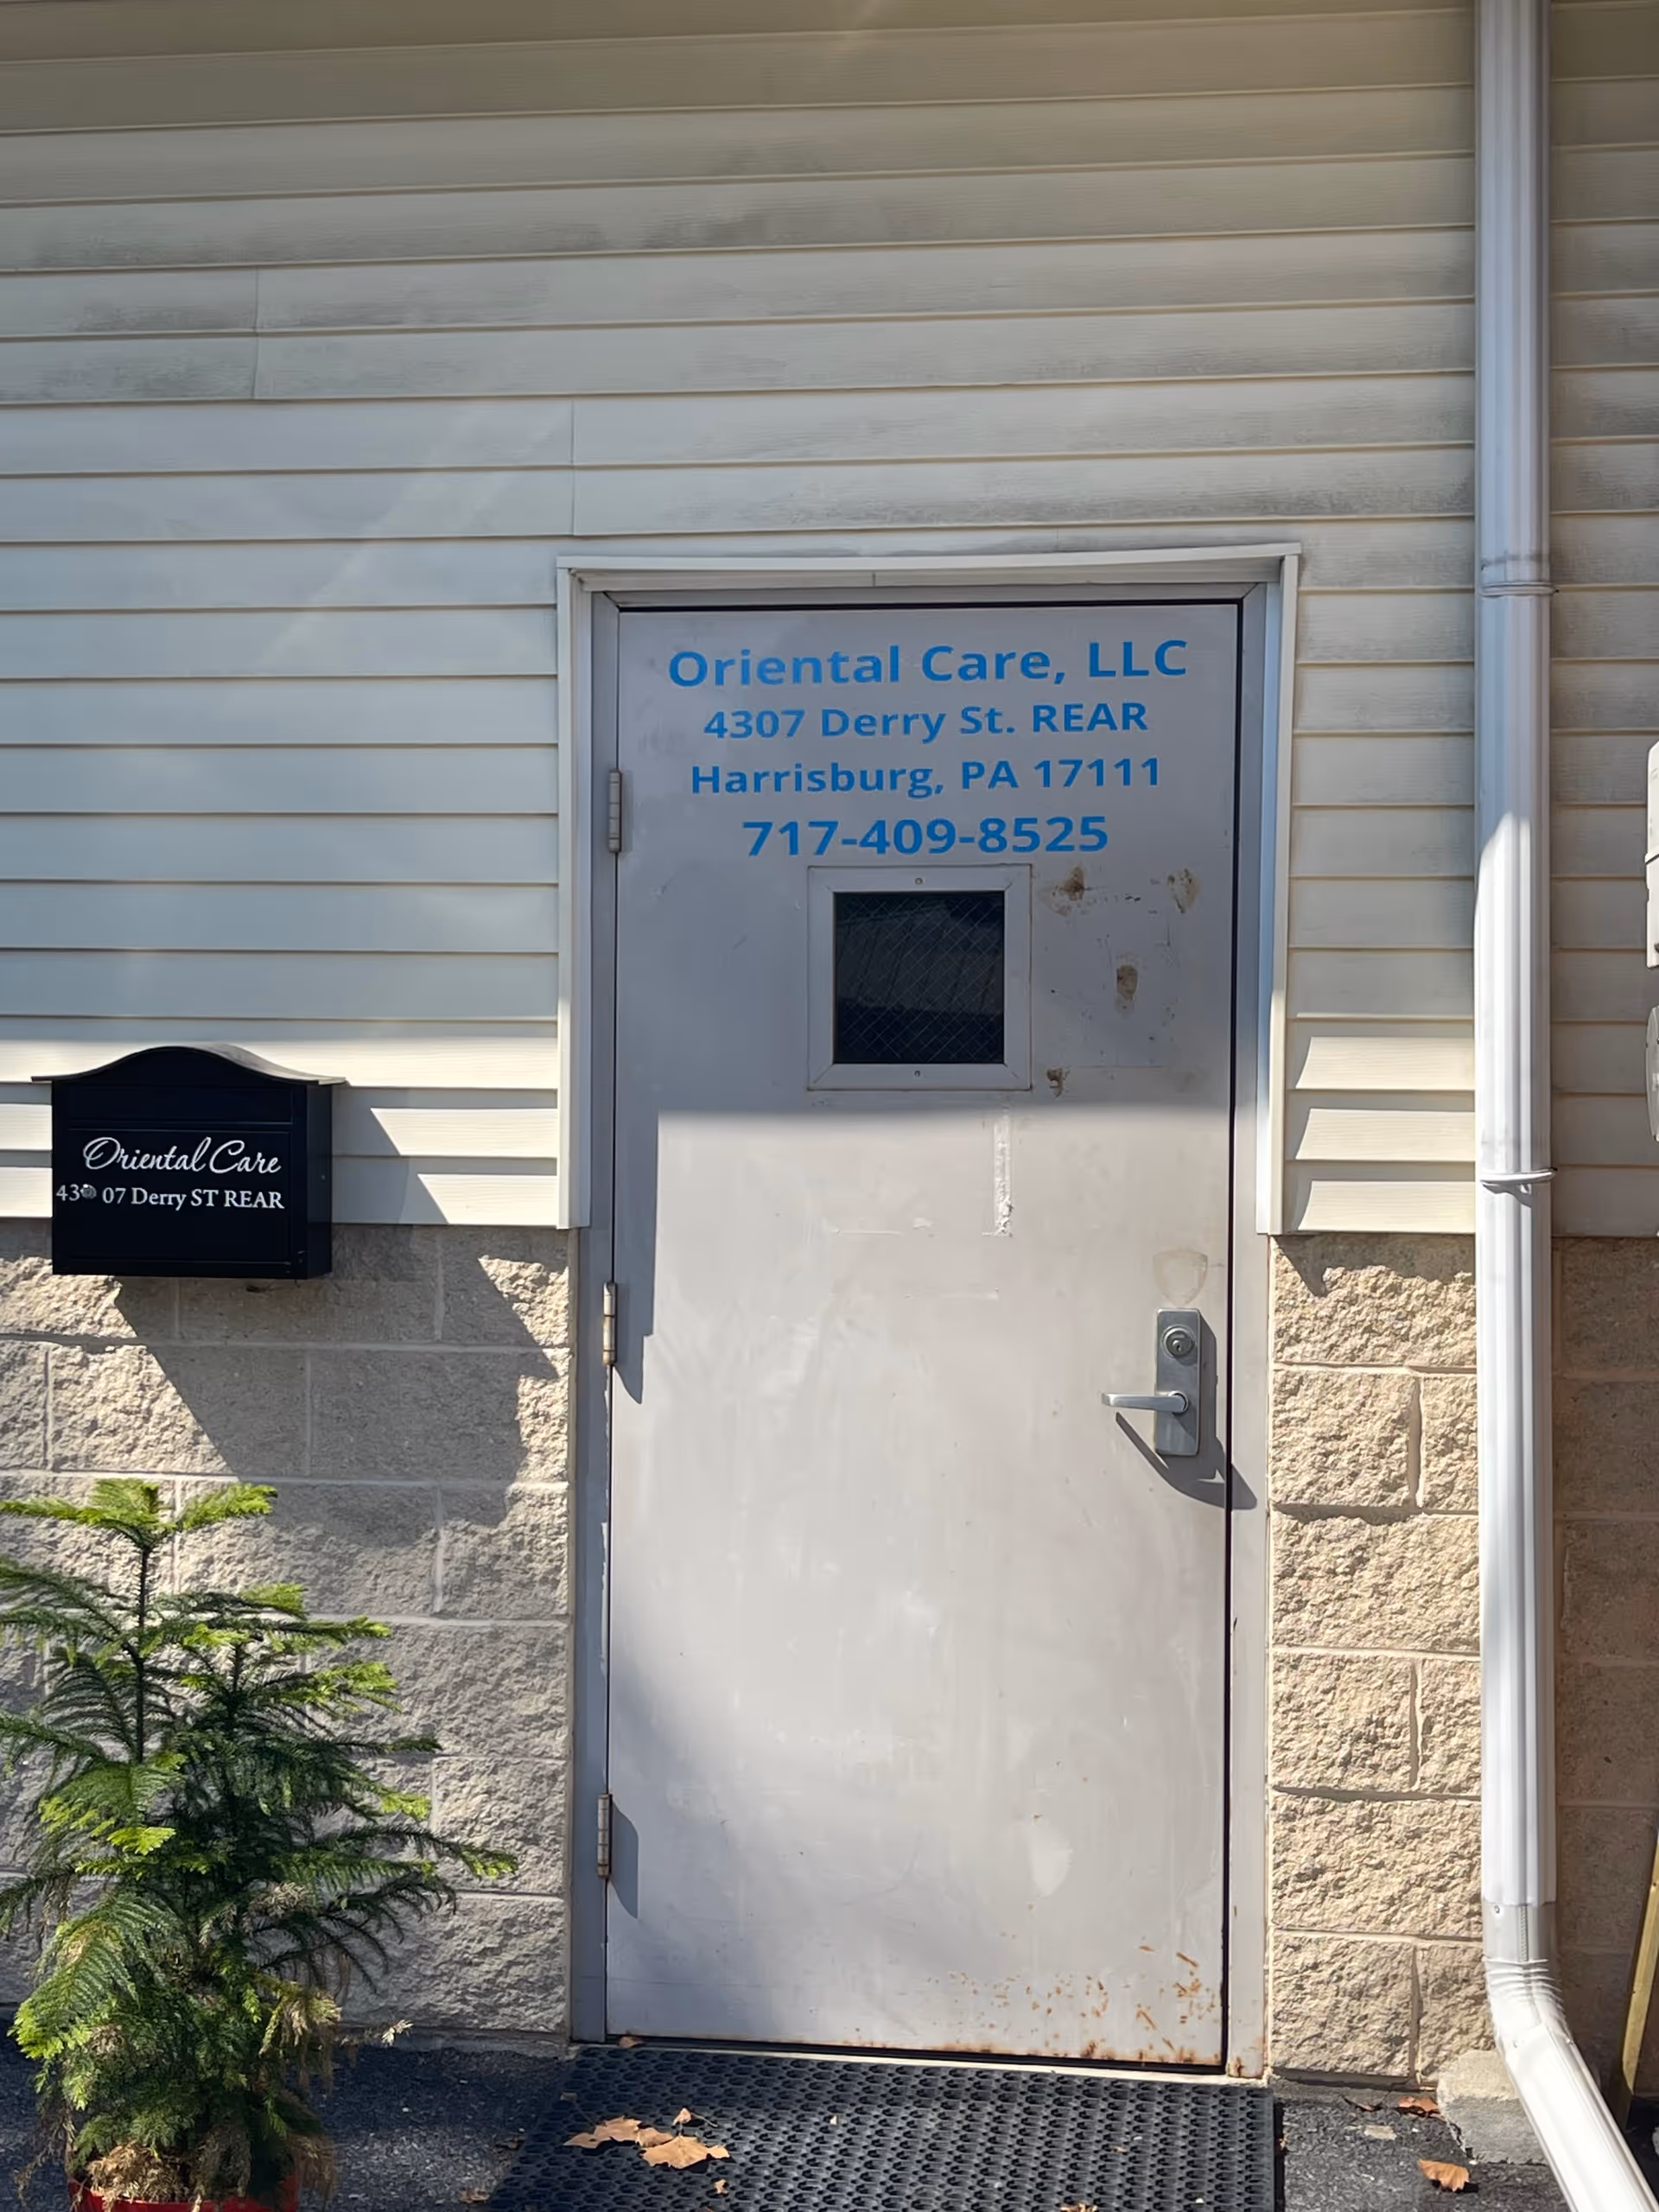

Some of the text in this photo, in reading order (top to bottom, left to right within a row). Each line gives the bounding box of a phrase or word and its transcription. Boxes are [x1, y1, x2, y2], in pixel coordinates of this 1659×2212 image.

[668, 639, 1188, 688] Oriental Care, LLC
[703, 701, 1148, 744] 4307 Derry St. REAR
[691, 757, 1159, 799] Harrisburg, PA 17111
[742, 815, 1109, 856] 717-409-8525
[83, 1136, 282, 1173] Oriental Care
[130, 1187, 188, 1211] Derry
[190, 1188, 219, 1207] ST
[224, 1190, 285, 1210] REAR
